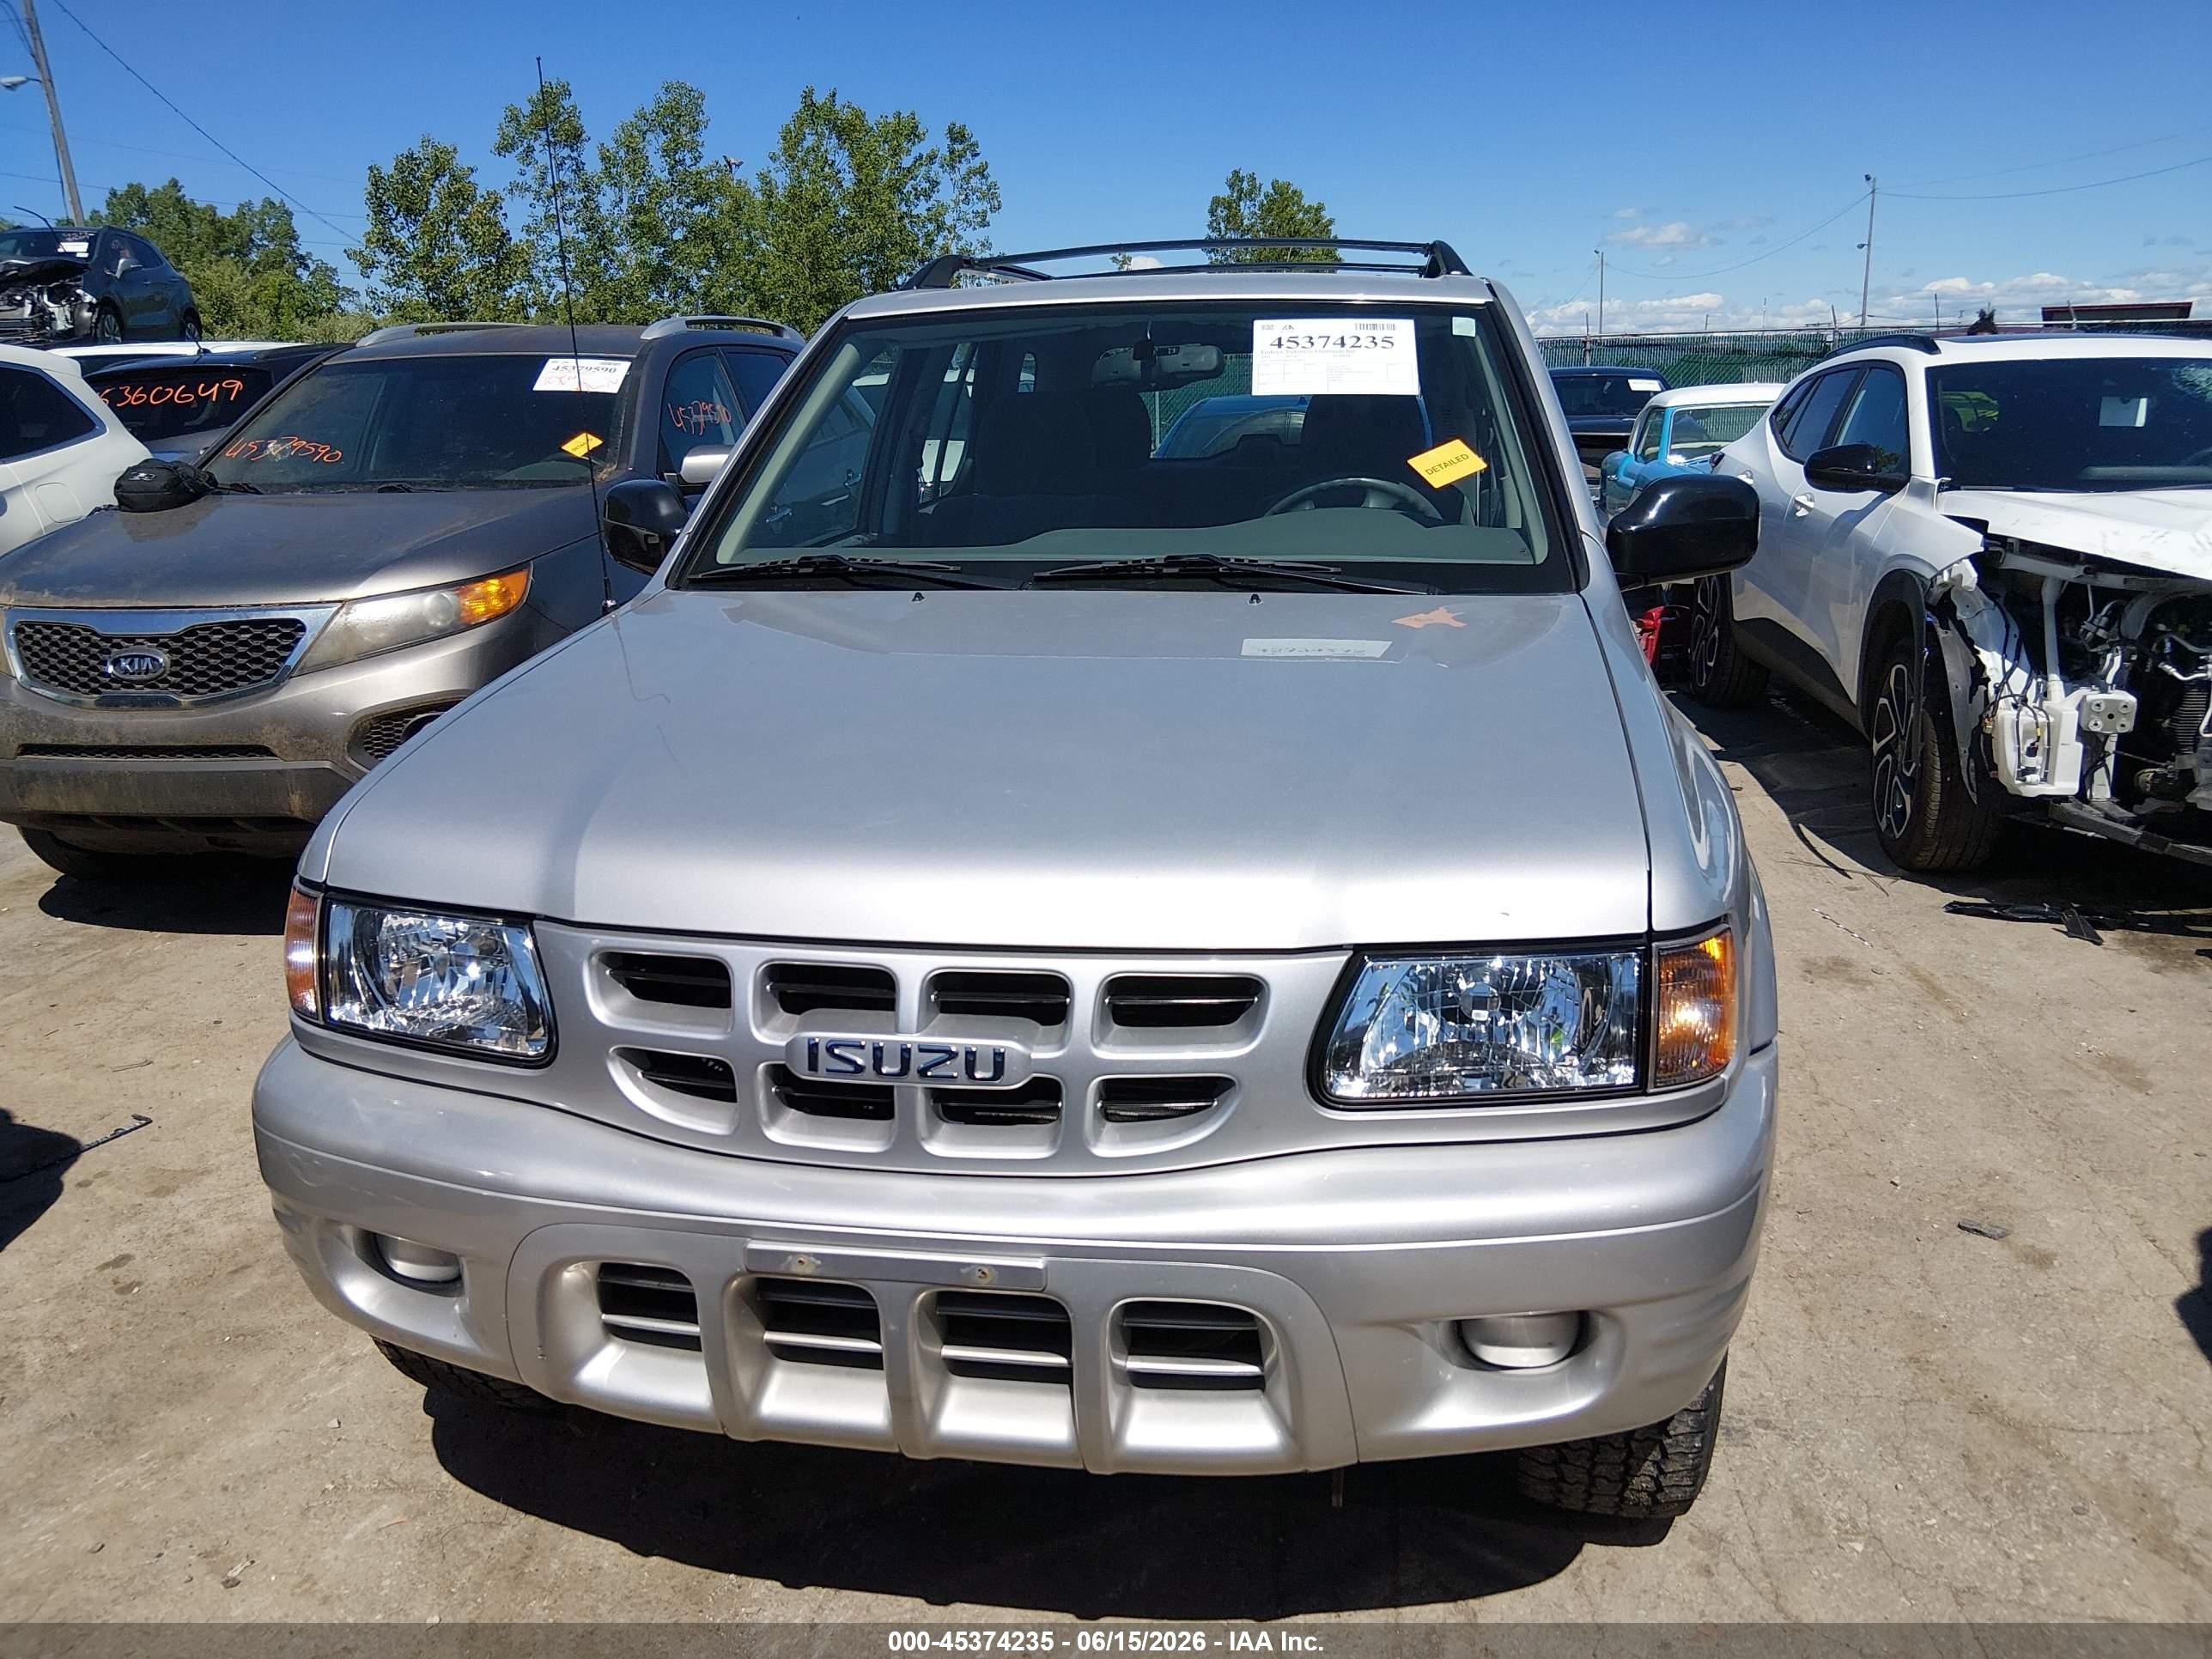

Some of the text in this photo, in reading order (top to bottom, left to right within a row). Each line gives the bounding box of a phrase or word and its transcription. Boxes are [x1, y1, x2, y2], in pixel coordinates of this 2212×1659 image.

[1270, 335, 1395, 349] 45374235
[1425, 453, 1469, 476] DETAILED
[118, 656, 155, 674] KIA
[807, 1037, 1005, 1082] ISUZU
